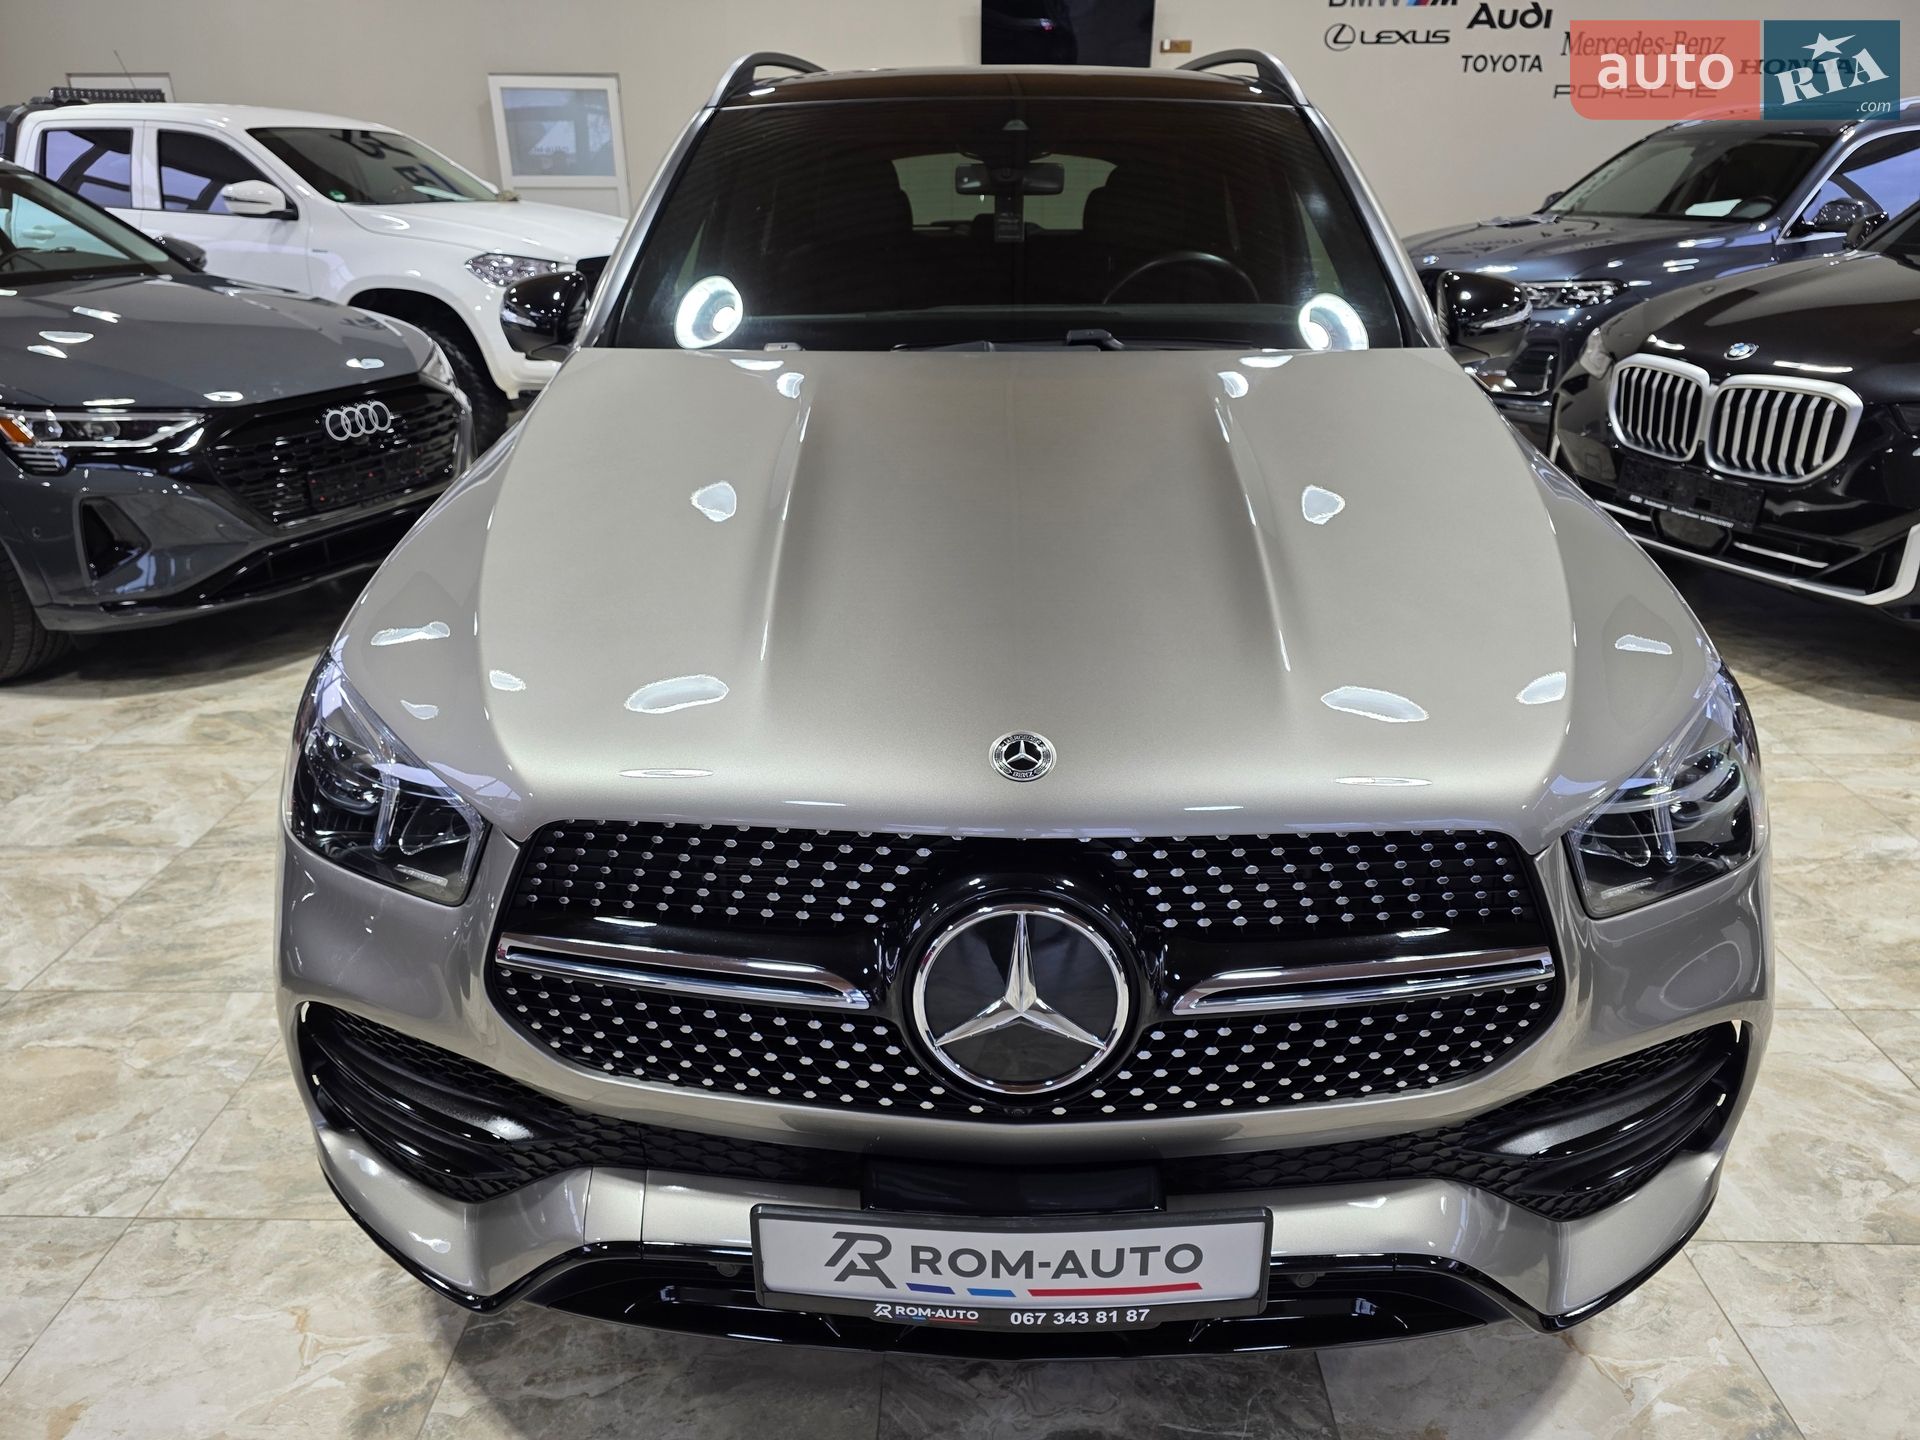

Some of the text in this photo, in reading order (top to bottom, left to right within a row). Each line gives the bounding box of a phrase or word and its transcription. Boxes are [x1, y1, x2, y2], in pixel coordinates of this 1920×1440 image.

[1466, 1, 1553, 30] Audi
[1360, 29, 1451, 45] LEXUS
[1560, 30, 1727, 57] Mercedes-Benz
[1461, 54, 1544, 73] TOYOTA
[910, 1242, 1204, 1280] ROM-AUTO
[895, 1305, 979, 1320] ROM-AUTO
[1010, 1309, 1150, 1325] 067 343 81 87
